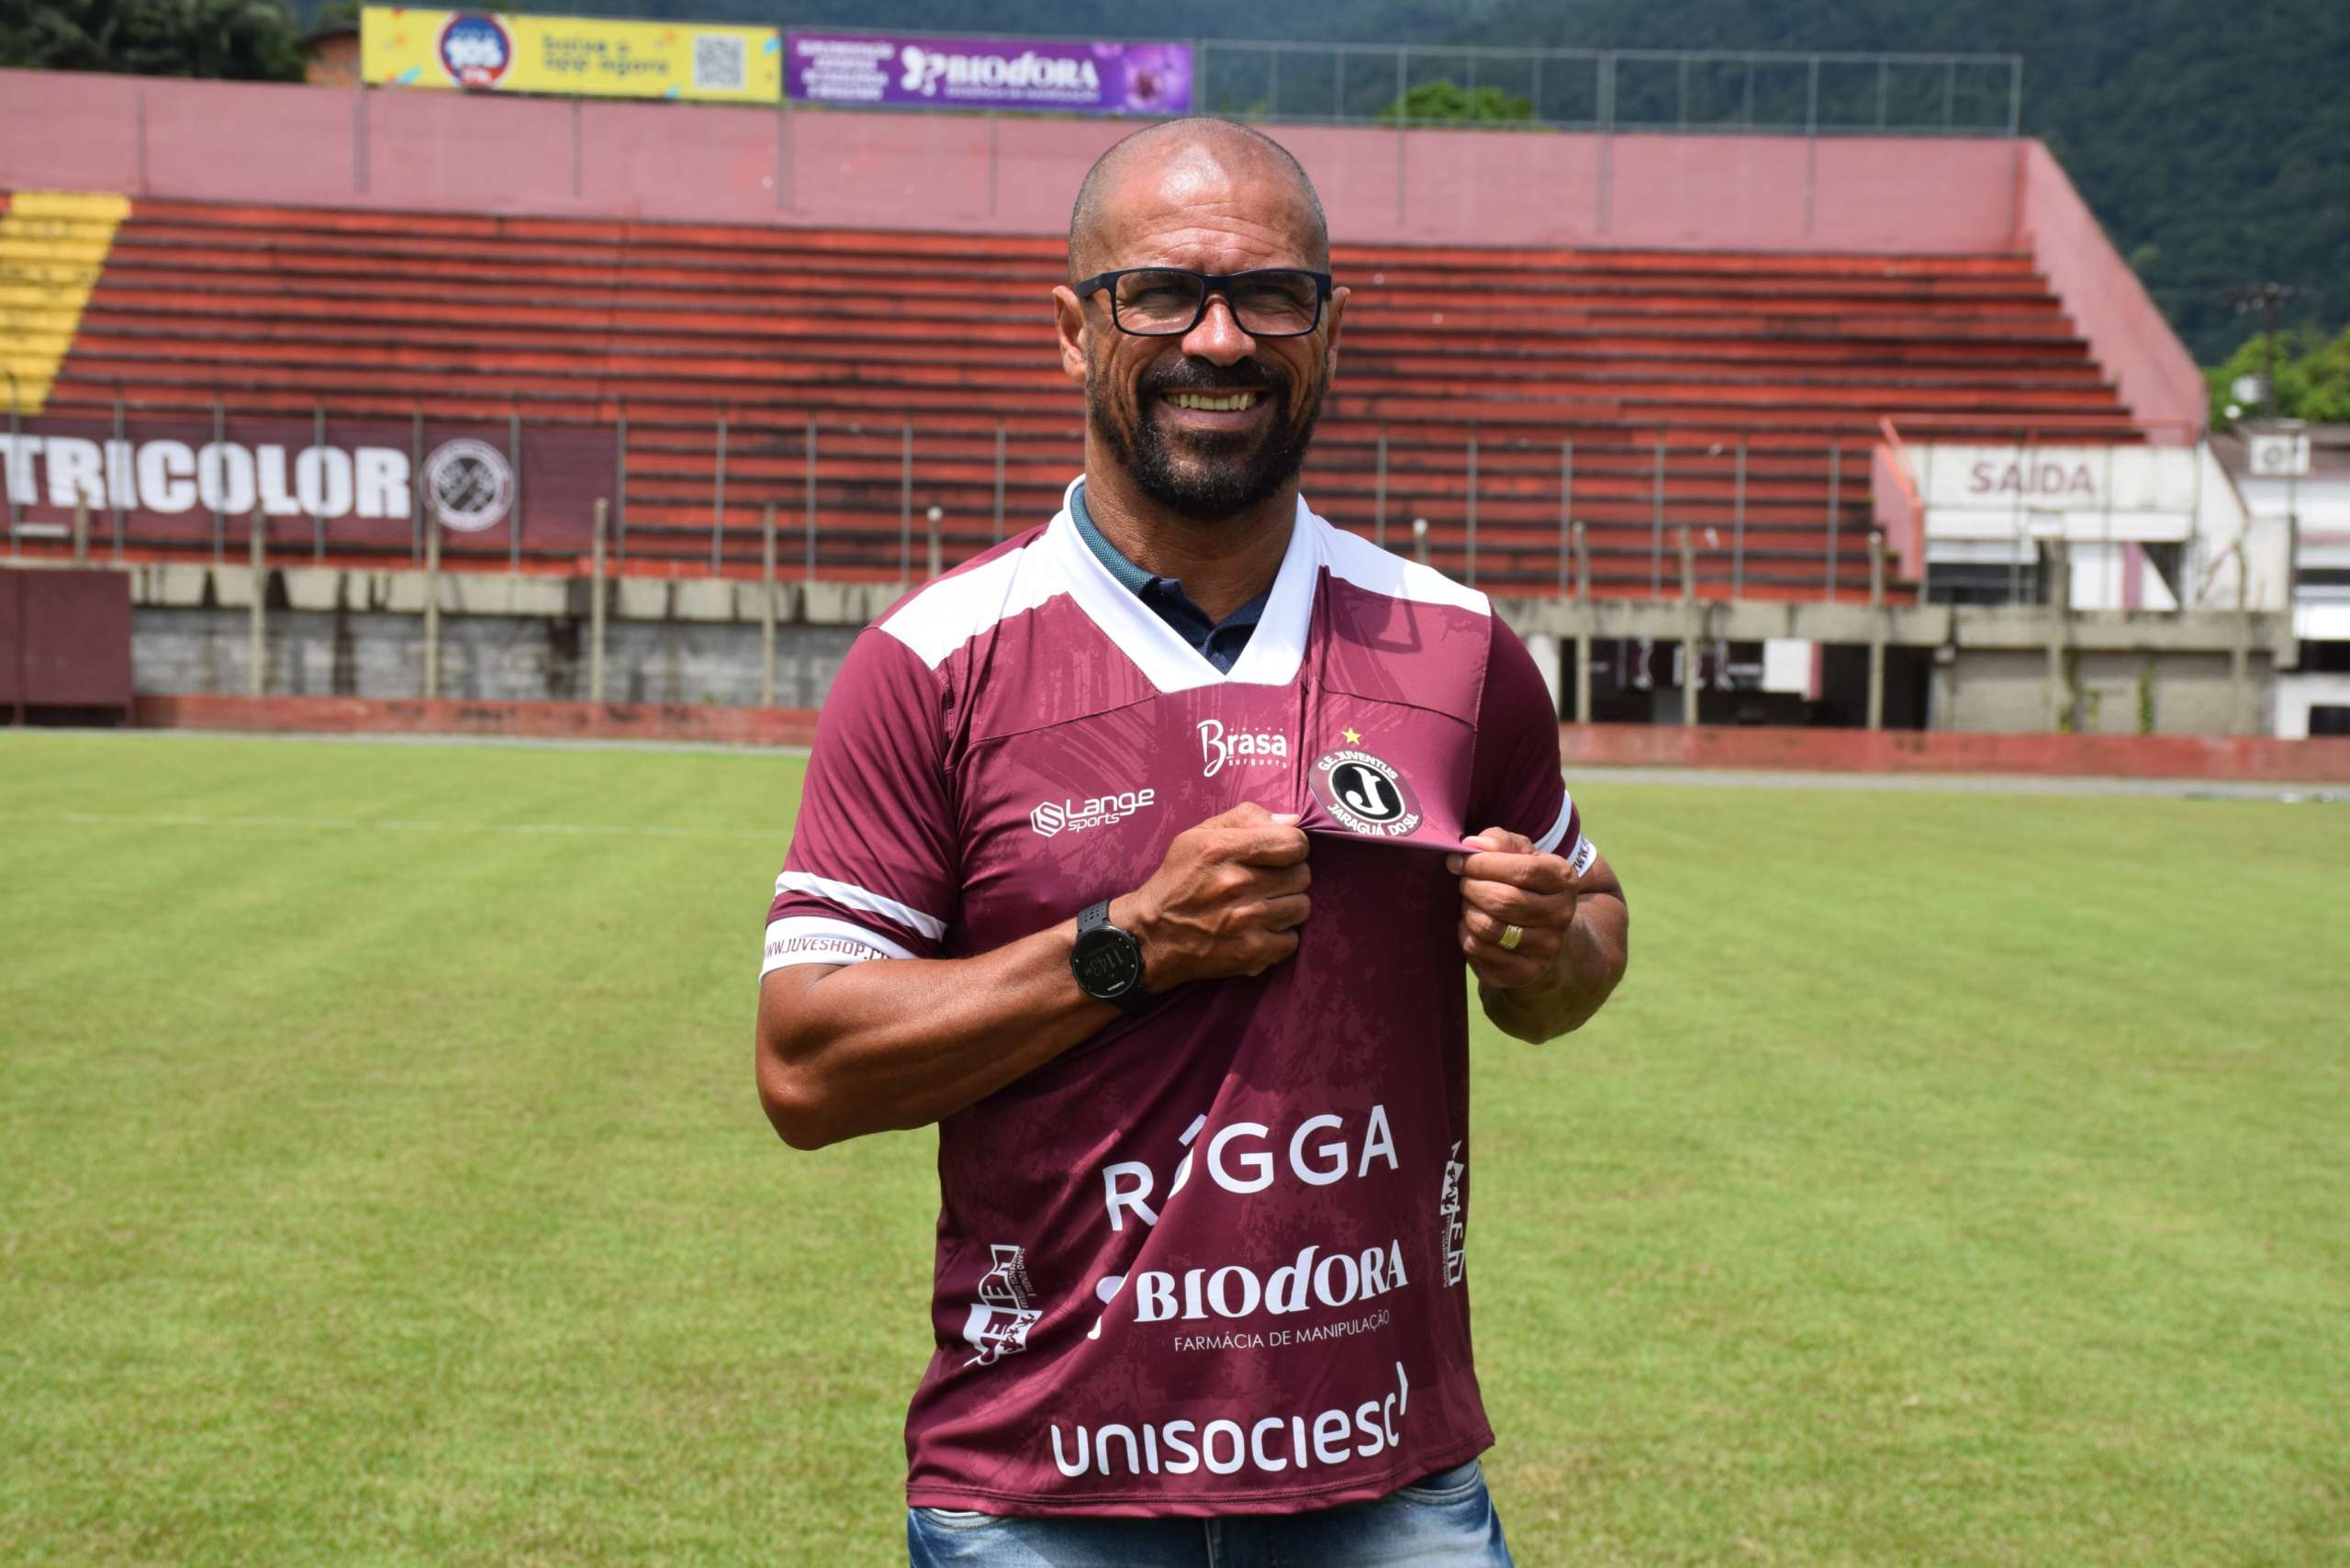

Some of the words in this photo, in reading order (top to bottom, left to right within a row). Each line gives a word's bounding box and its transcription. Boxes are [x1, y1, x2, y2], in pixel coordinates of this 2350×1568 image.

[0, 432, 411, 520] TRICOLOR
[1196, 719, 1287, 778] Brasa
[1334, 750, 1399, 780] JUVENTUS
[1065, 788, 1156, 819] Lange
[1068, 812, 1121, 833] sports
[1387, 822, 1408, 836] DO
[1173, 1330, 1265, 1352] FARMÁCIA
[1270, 1330, 1292, 1347] DE
[1296, 1309, 1391, 1344] MANIPULAÇÃO
